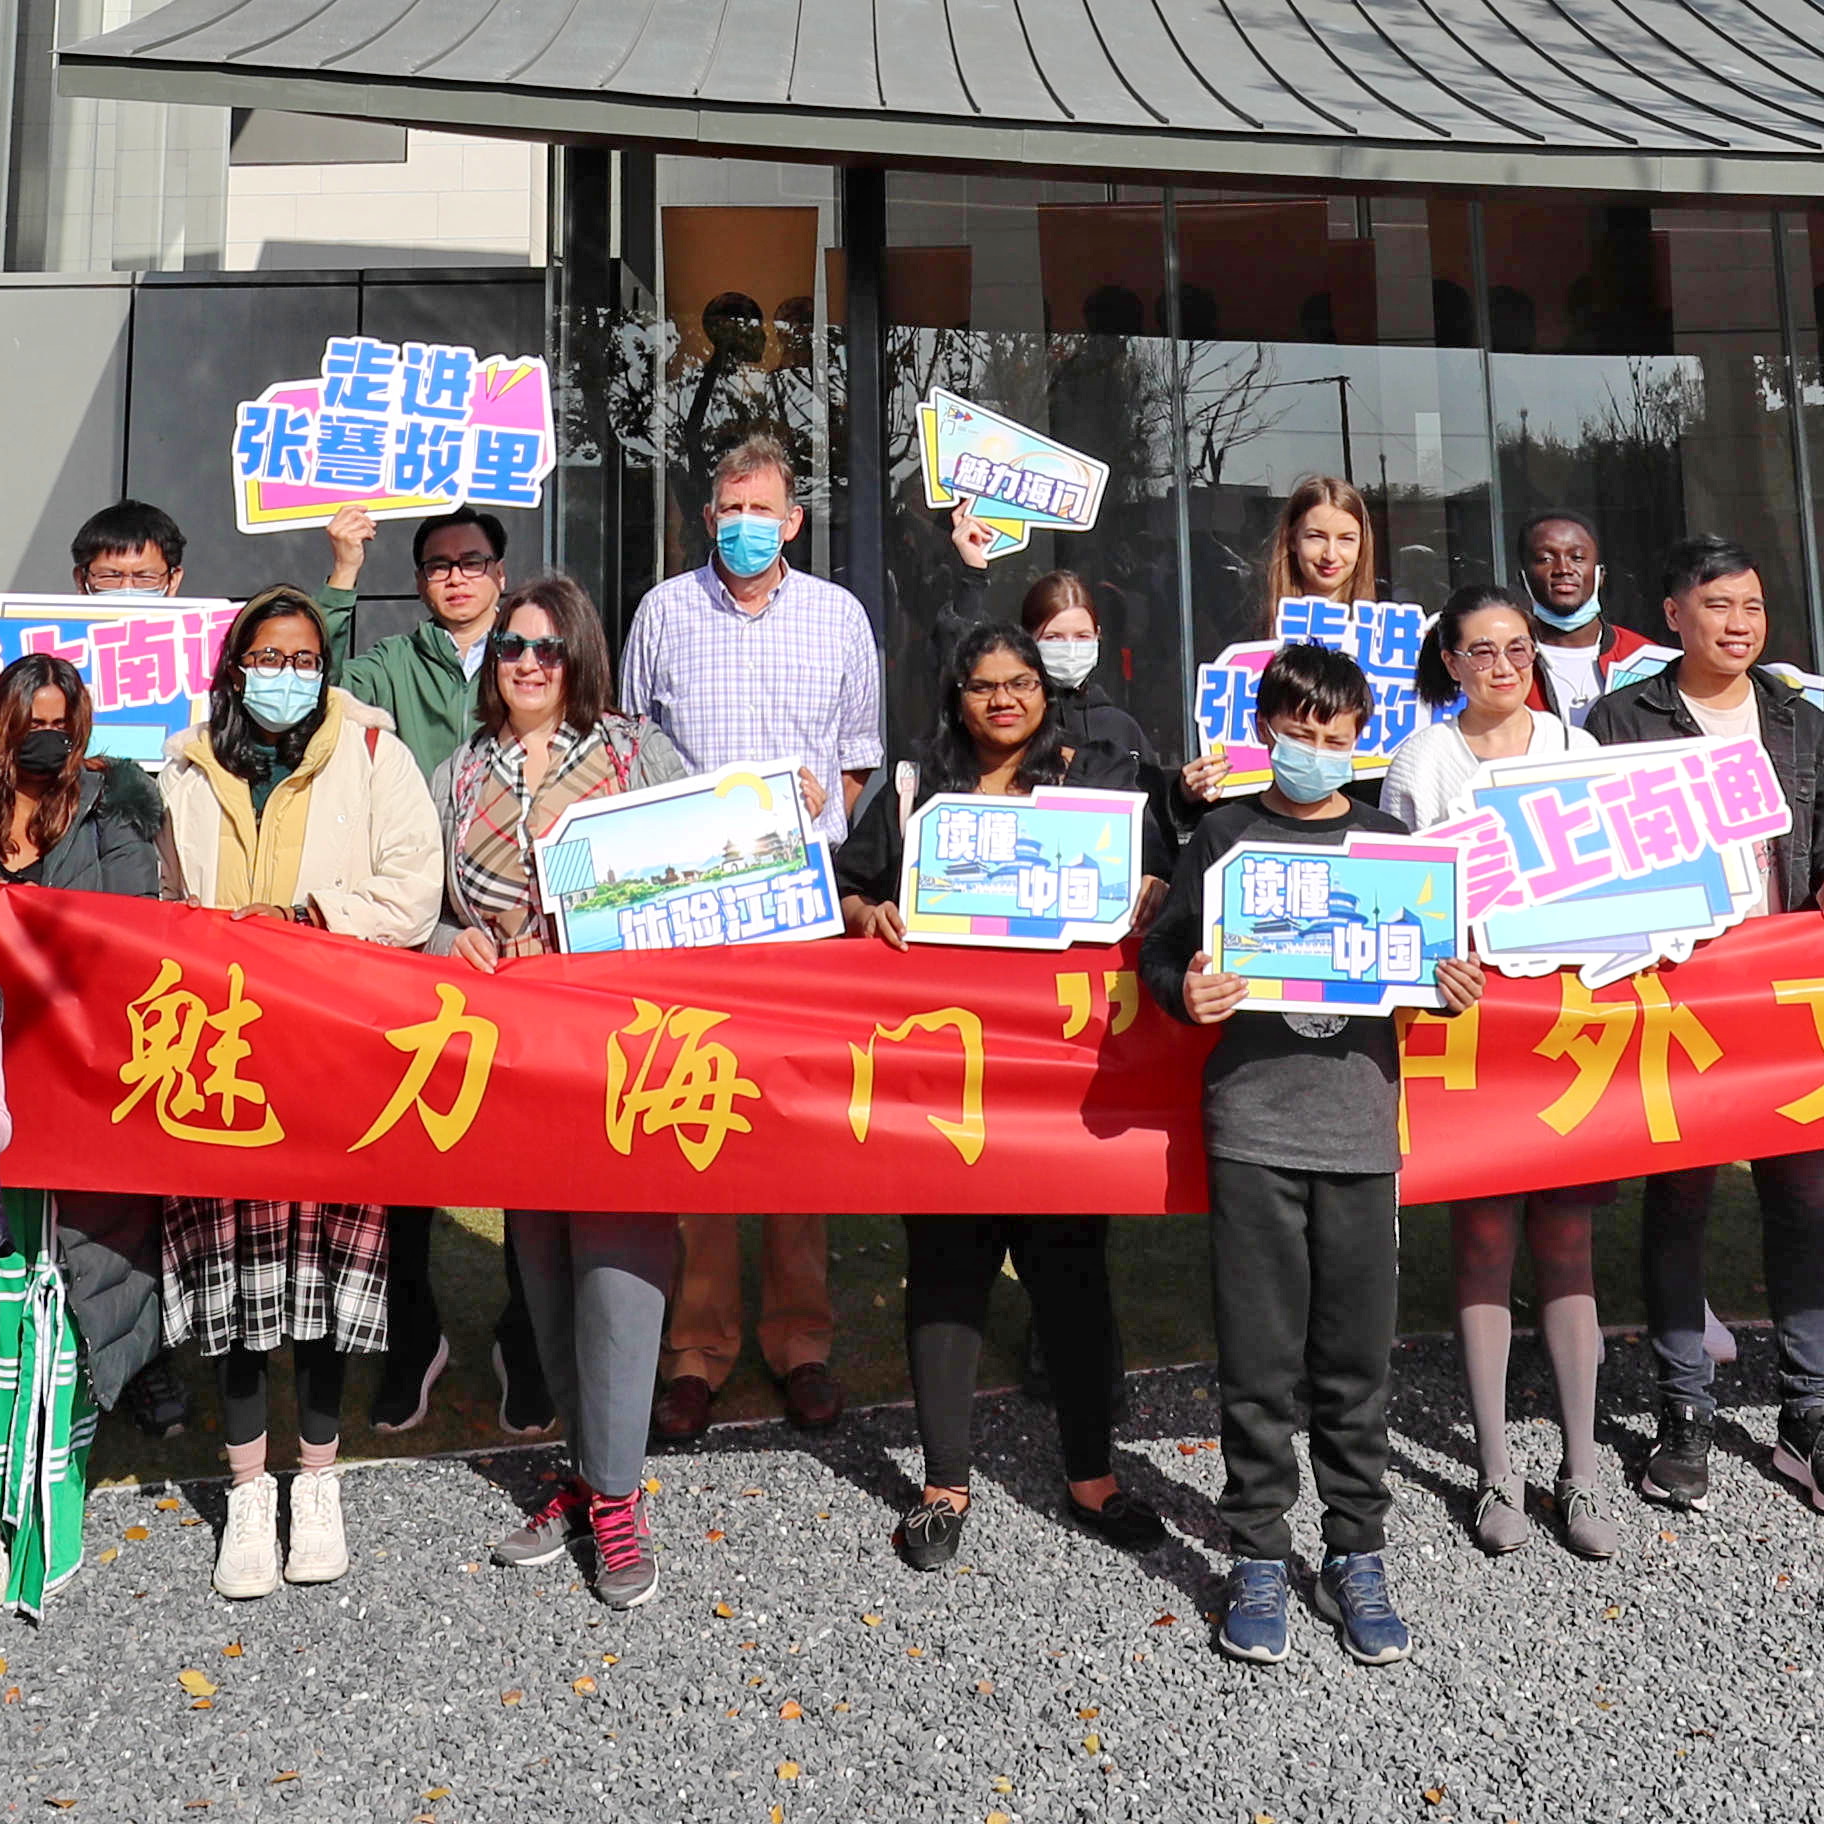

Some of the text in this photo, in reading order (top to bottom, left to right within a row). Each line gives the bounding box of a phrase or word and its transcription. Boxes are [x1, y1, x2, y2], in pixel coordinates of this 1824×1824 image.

[324, 341, 474, 421] 走进
[237, 406, 540, 504] 张謇故里
[953, 452, 1090, 521] 魅力海门
[936, 808, 1018, 862] 读懂
[618, 869, 827, 951] 体验江苏
[1017, 865, 1099, 919] 中国
[1242, 857, 1331, 918] 读懂
[1333, 921, 1422, 982] 中国
